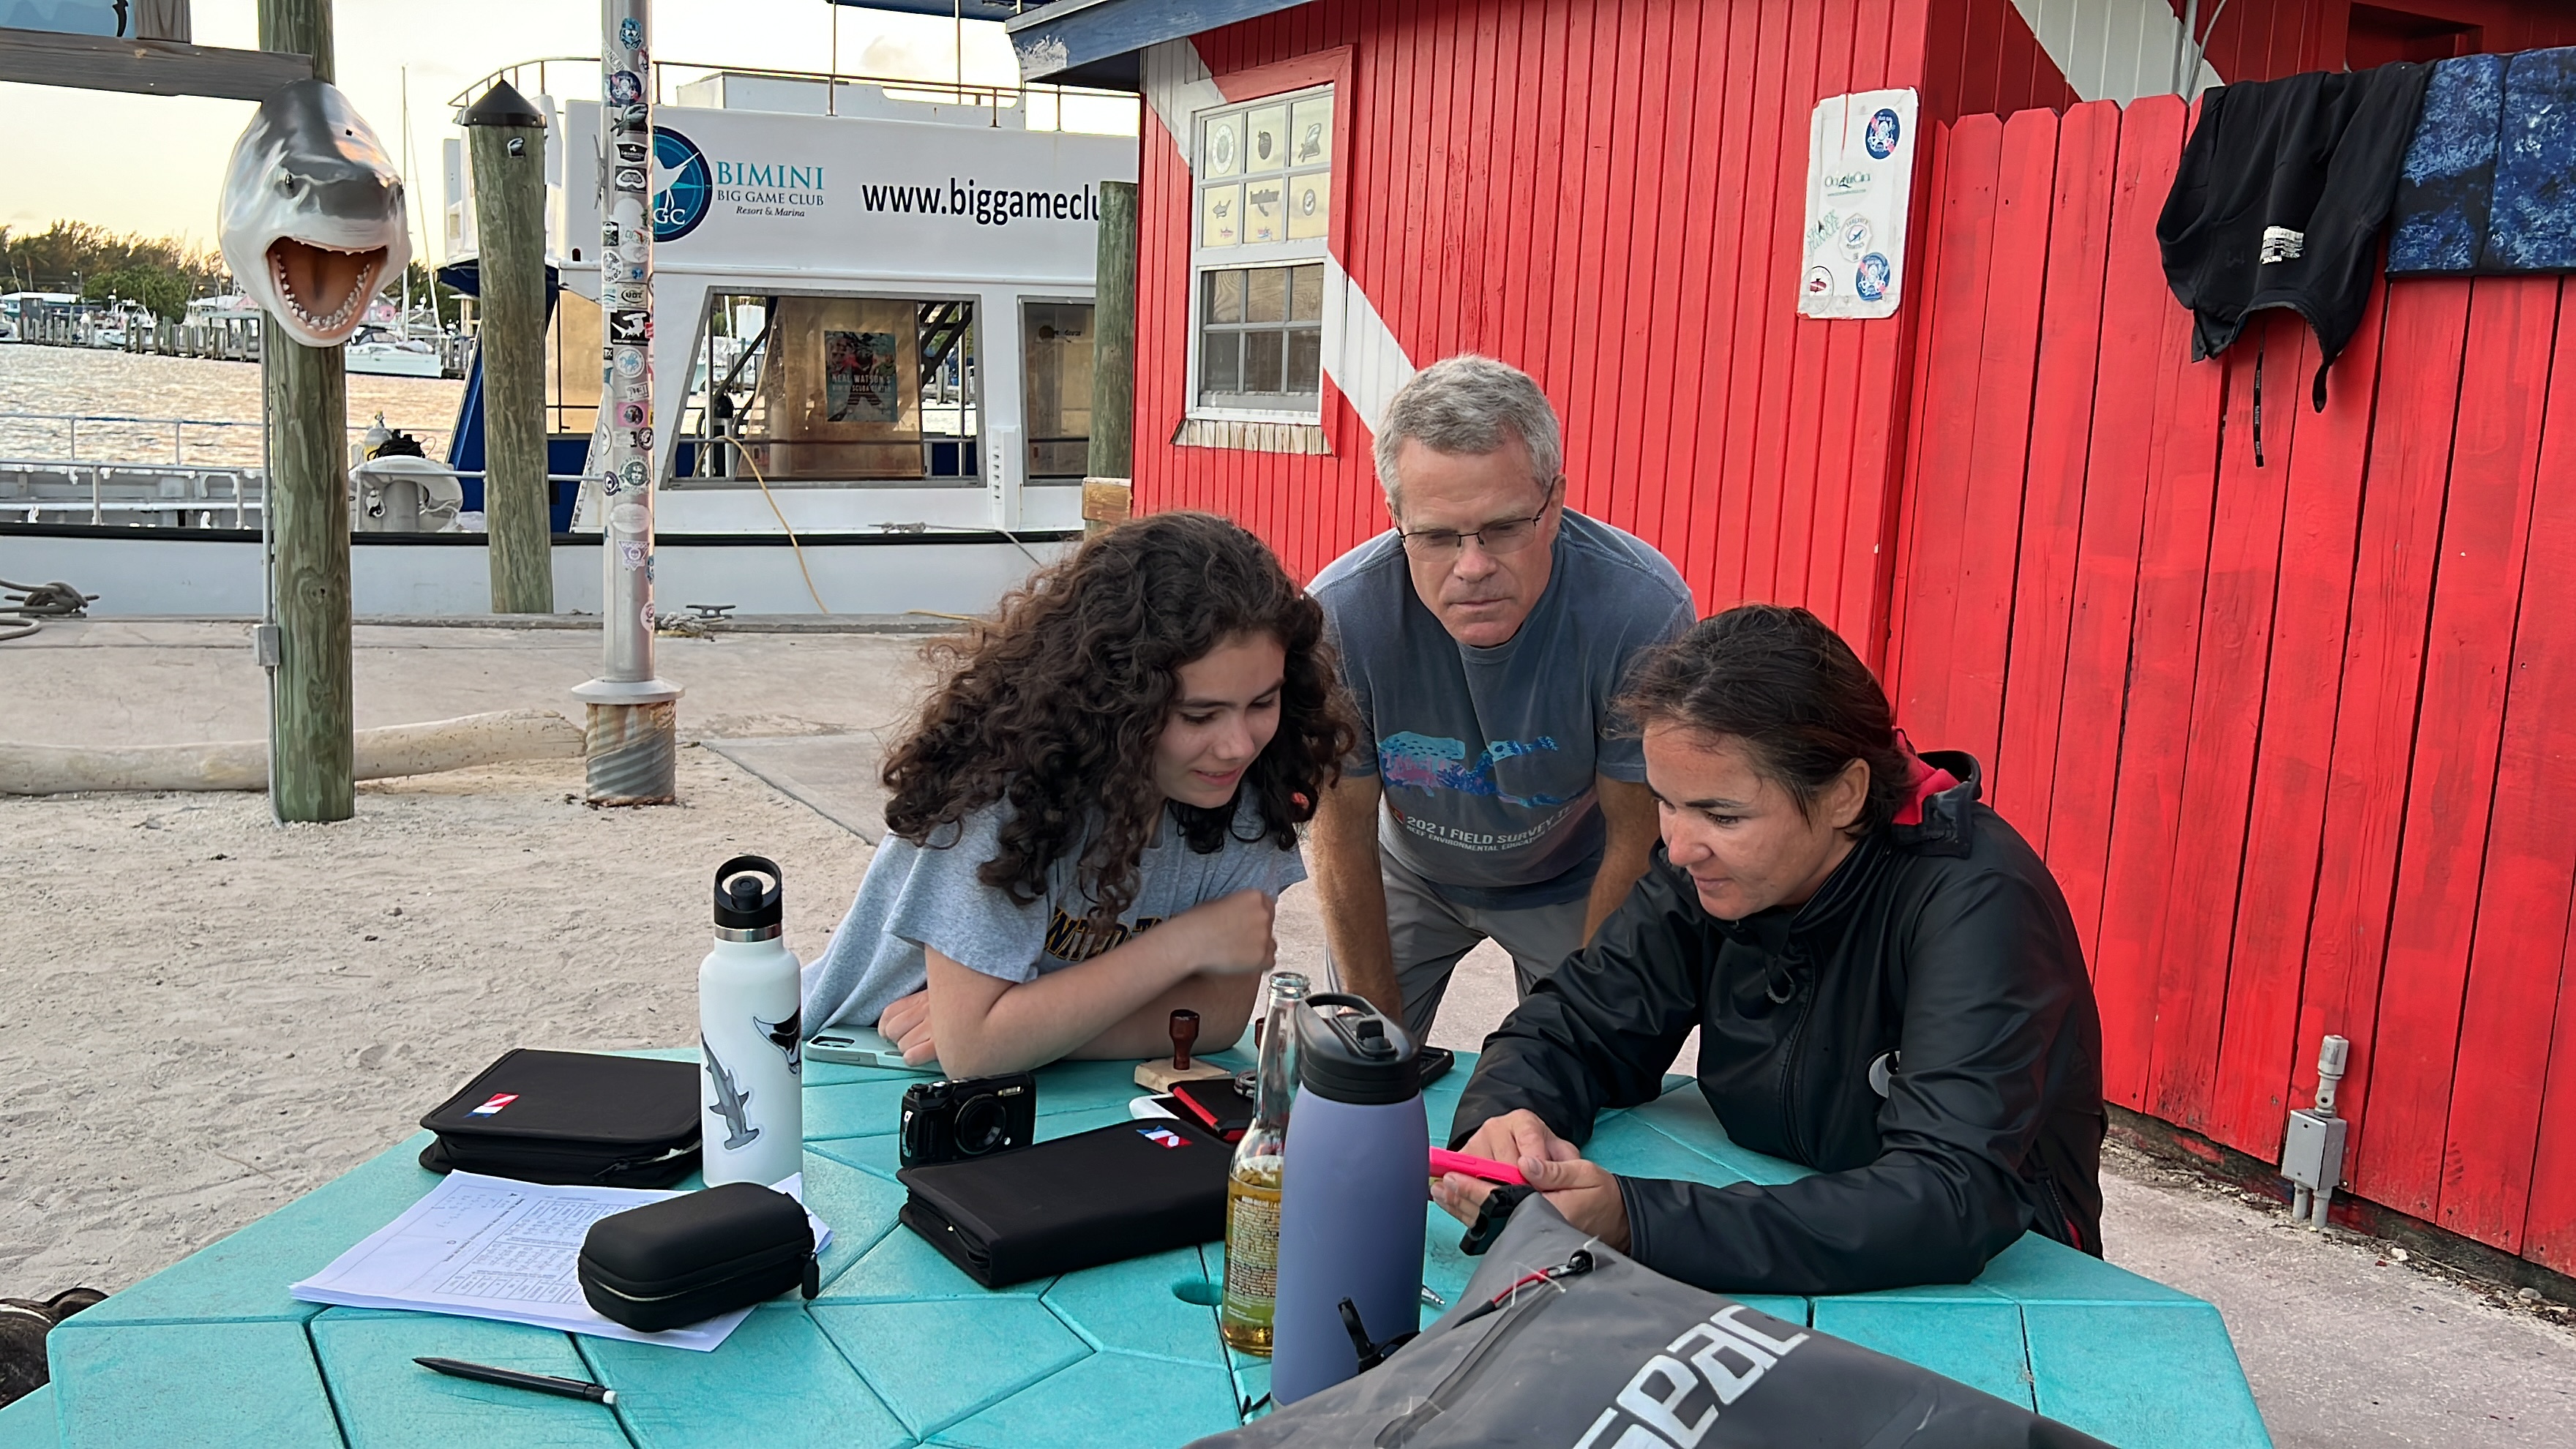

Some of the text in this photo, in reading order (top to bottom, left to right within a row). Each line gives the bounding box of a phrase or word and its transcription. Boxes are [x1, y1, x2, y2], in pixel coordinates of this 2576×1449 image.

[716, 160, 824, 190] BIMINI
[717, 190, 824, 206] BIG GAME CLUB
[735, 206, 805, 217] Resort & Marina
[1407, 816, 1445, 836] 2021
[1450, 828, 1494, 845] FIELD
[1497, 815, 1554, 844] SURVEY
[1407, 825, 1426, 837] REEF
[1429, 834, 1499, 852] ENVIRONMENTAL
